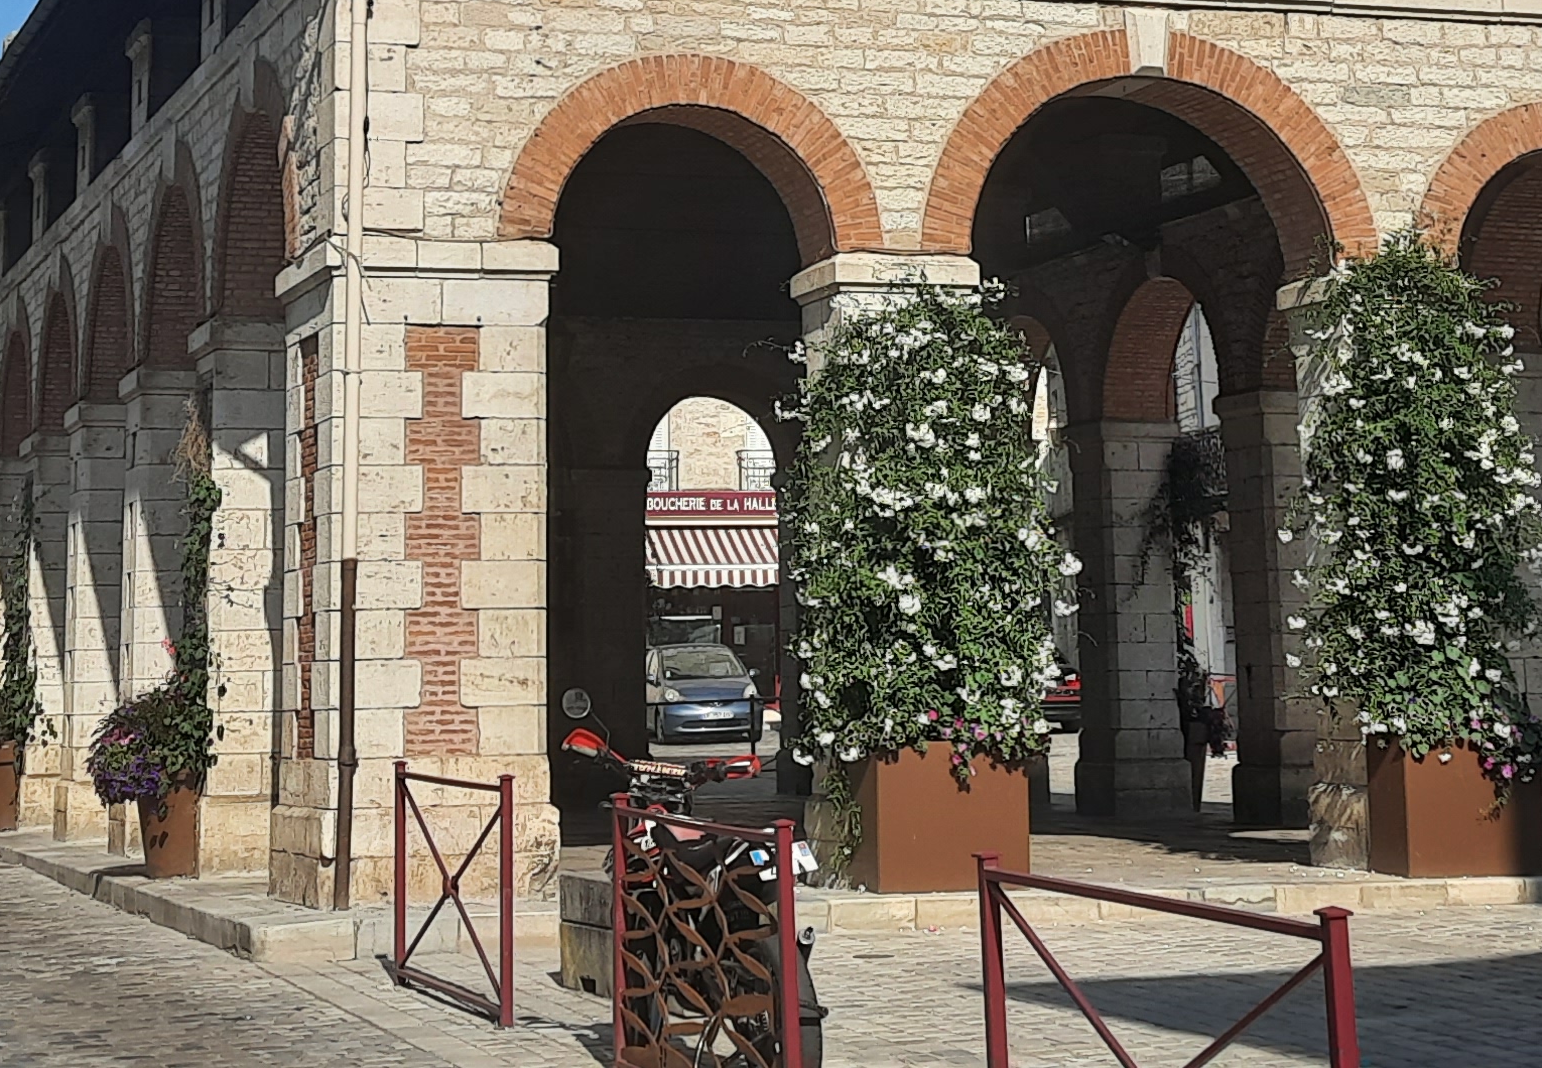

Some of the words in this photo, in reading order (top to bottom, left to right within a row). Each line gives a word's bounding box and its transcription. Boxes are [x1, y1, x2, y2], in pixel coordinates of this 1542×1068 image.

[646, 497, 706, 511] BOUCHERIE
[710, 498, 724, 511] DE
[727, 498, 740, 512] LA
